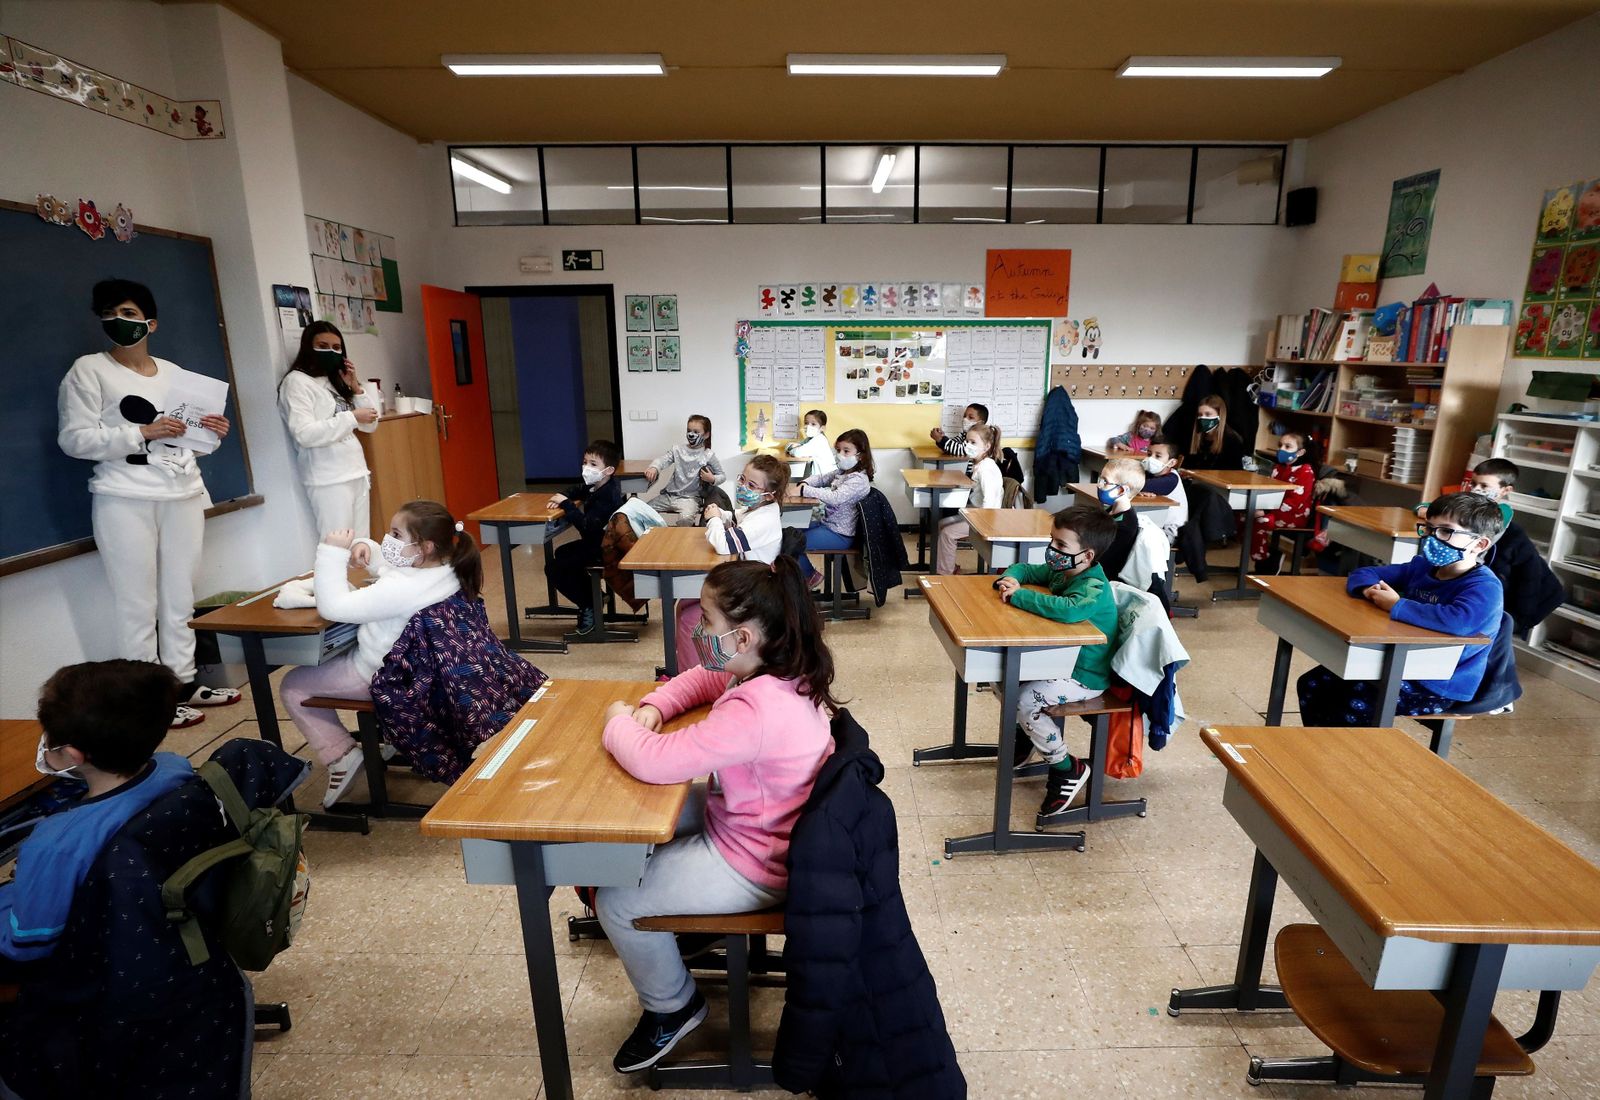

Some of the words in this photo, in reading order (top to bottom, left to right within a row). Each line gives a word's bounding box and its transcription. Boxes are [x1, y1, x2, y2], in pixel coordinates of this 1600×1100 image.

[990, 253, 1056, 280] Autumn
[1009, 286, 1027, 300] the
[1356, 292, 1369, 301] 3
[1561, 329, 1573, 339] oy
